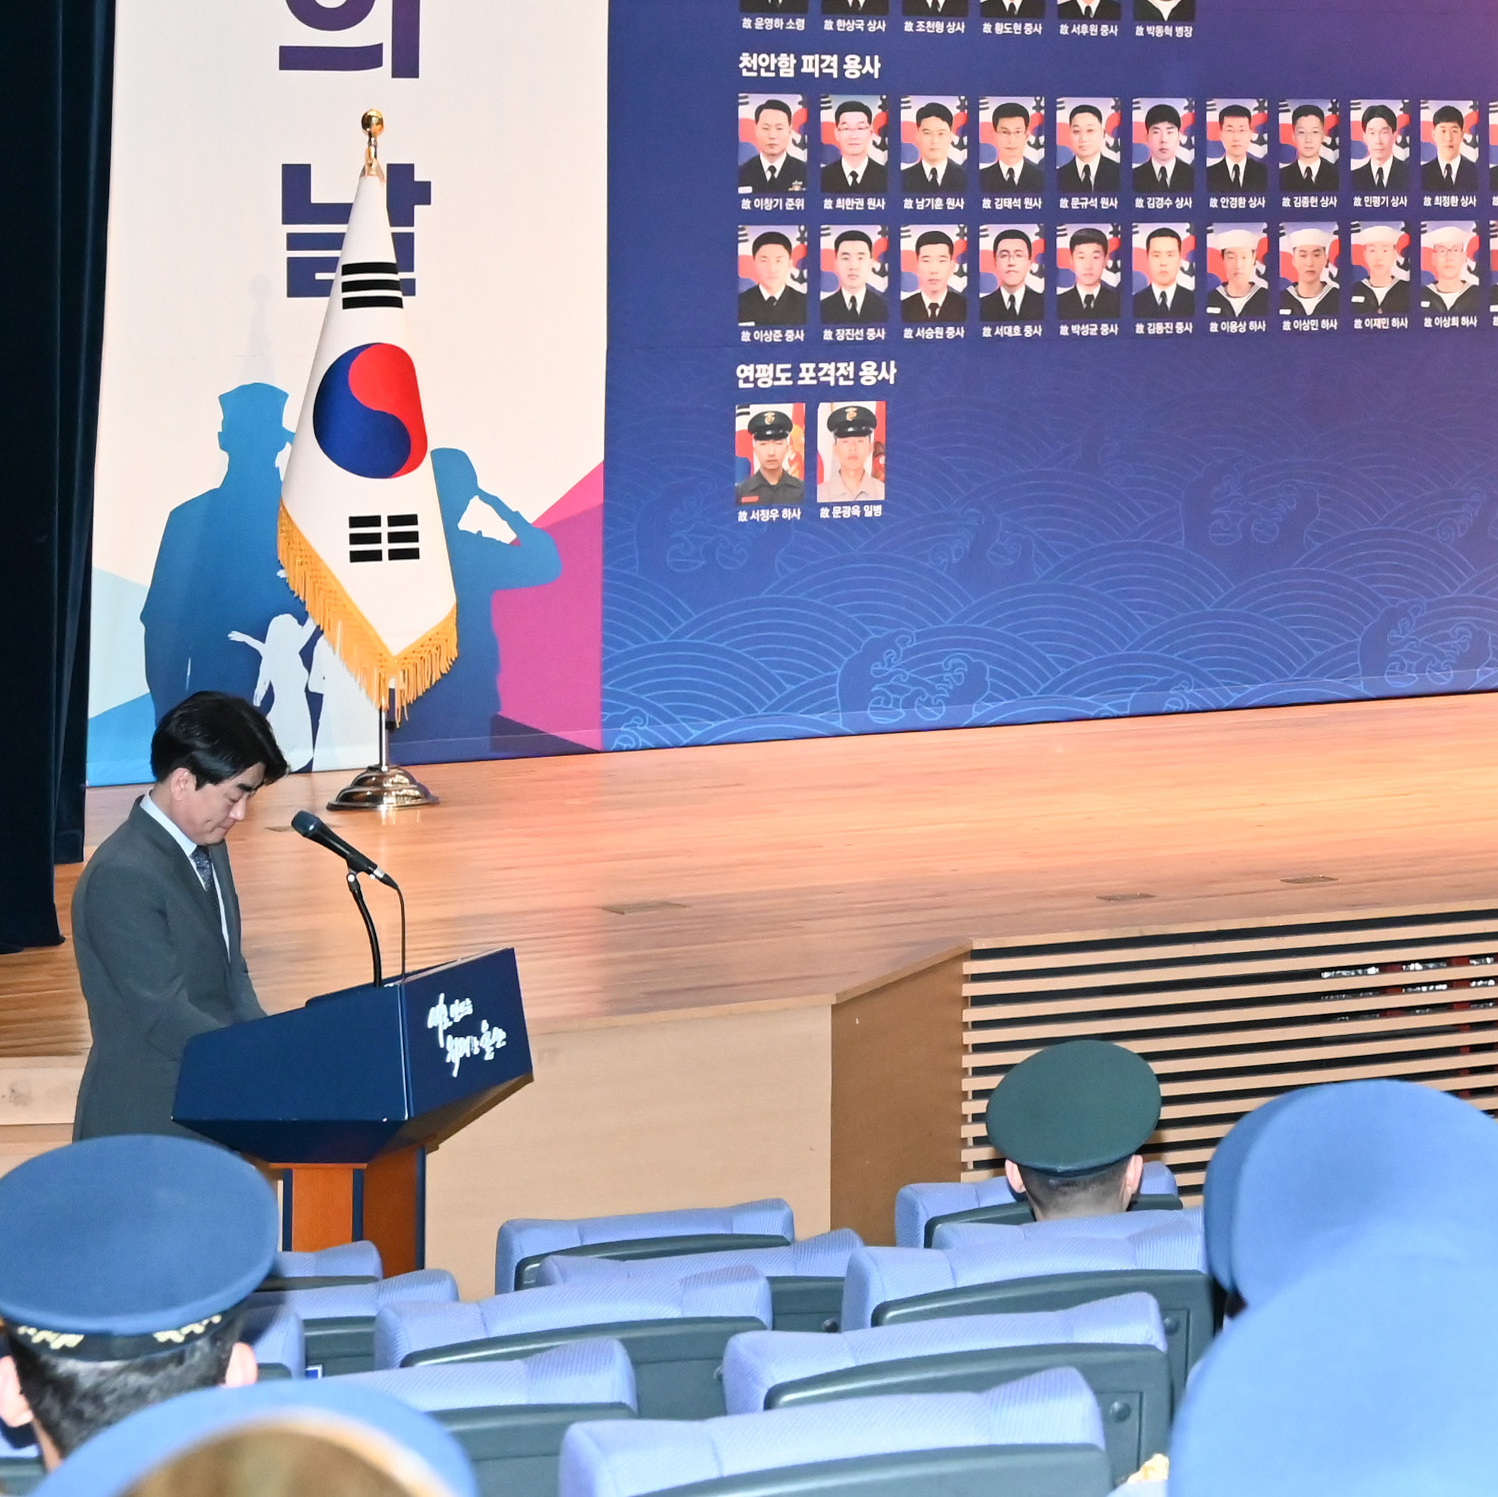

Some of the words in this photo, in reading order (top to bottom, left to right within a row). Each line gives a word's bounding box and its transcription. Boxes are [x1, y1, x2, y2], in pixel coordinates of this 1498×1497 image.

[742, 18, 752, 29] 故
[755, 18, 784, 30] 윤영하
[785, 18, 805, 30] 소령
[824, 19, 833, 30] 故
[836, 19, 865, 31] 한상국
[867, 20, 886, 32] 상사
[904, 21, 913, 32] 故
[916, 21, 944, 33] 조천형
[946, 22, 965, 33] 상사
[983, 23, 991, 33] 故
[1024, 23, 1042, 35] 중사
[1060, 24, 1069, 35] 故
[1100, 25, 1118, 36] 중사
[1136, 26, 1144, 36] 故
[1175, 26, 1192, 37] 병장
[739, 52, 797, 77] 천안함
[800, 54, 839, 78] 피격
[843, 54, 881, 78] 용사
[742, 199, 751, 210] 故
[785, 199, 804, 210] 준위
[824, 199, 833, 210] 故
[867, 198, 885, 210] 원사
[904, 198, 913, 210] 故
[946, 198, 964, 210] 원사
[982, 198, 991, 209] 故
[1024, 198, 1042, 209] 원사
[1060, 198, 1069, 209] 故
[1100, 197, 1118, 209] 원사
[1136, 198, 1144, 209] 故
[1175, 197, 1192, 209] 상사
[1210, 197, 1218, 208] 故
[1248, 196, 1265, 208] 상사
[281, 163, 431, 298] 날
[983, 327, 991, 337] 故
[1024, 325, 1042, 337] 중사
[1060, 325, 1069, 336] 故
[1100, 324, 1118, 335] 중사
[1210, 322, 1218, 332] 故
[1249, 320, 1266, 332] 하사
[1283, 321, 1291, 331] 故
[1321, 319, 1337, 330] 하사
[741, 331, 751, 341] 故
[785, 329, 804, 341] 중사
[904, 328, 913, 339] 故
[946, 327, 964, 339] 중사
[736, 363, 793, 388] 연평도
[798, 362, 854, 386] 포격전
[859, 360, 898, 385] 용사
[738, 510, 748, 522] 故
[782, 508, 801, 520] 하사
[820, 507, 829, 518] 故
[863, 505, 882, 517] 일병
